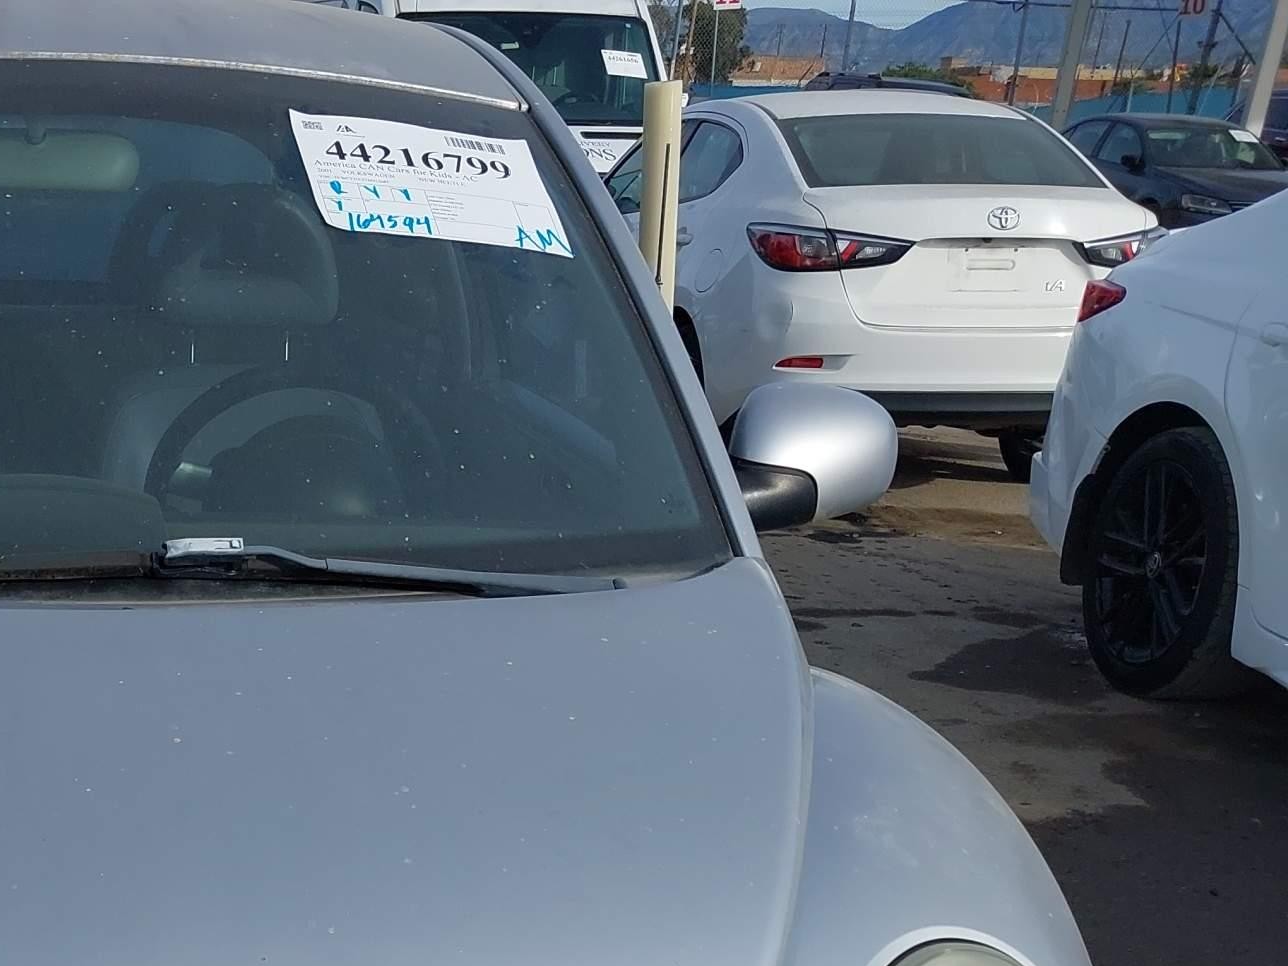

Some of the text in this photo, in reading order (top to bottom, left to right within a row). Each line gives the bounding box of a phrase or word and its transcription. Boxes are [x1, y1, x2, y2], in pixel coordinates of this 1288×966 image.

[314, 159, 356, 169] America
[358, 163, 384, 172] CAN
[387, 166, 410, 175] Cars
[429, 169, 452, 179] Kids
[462, 174, 479, 183] AC
[325, 140, 511, 180] 44216799
